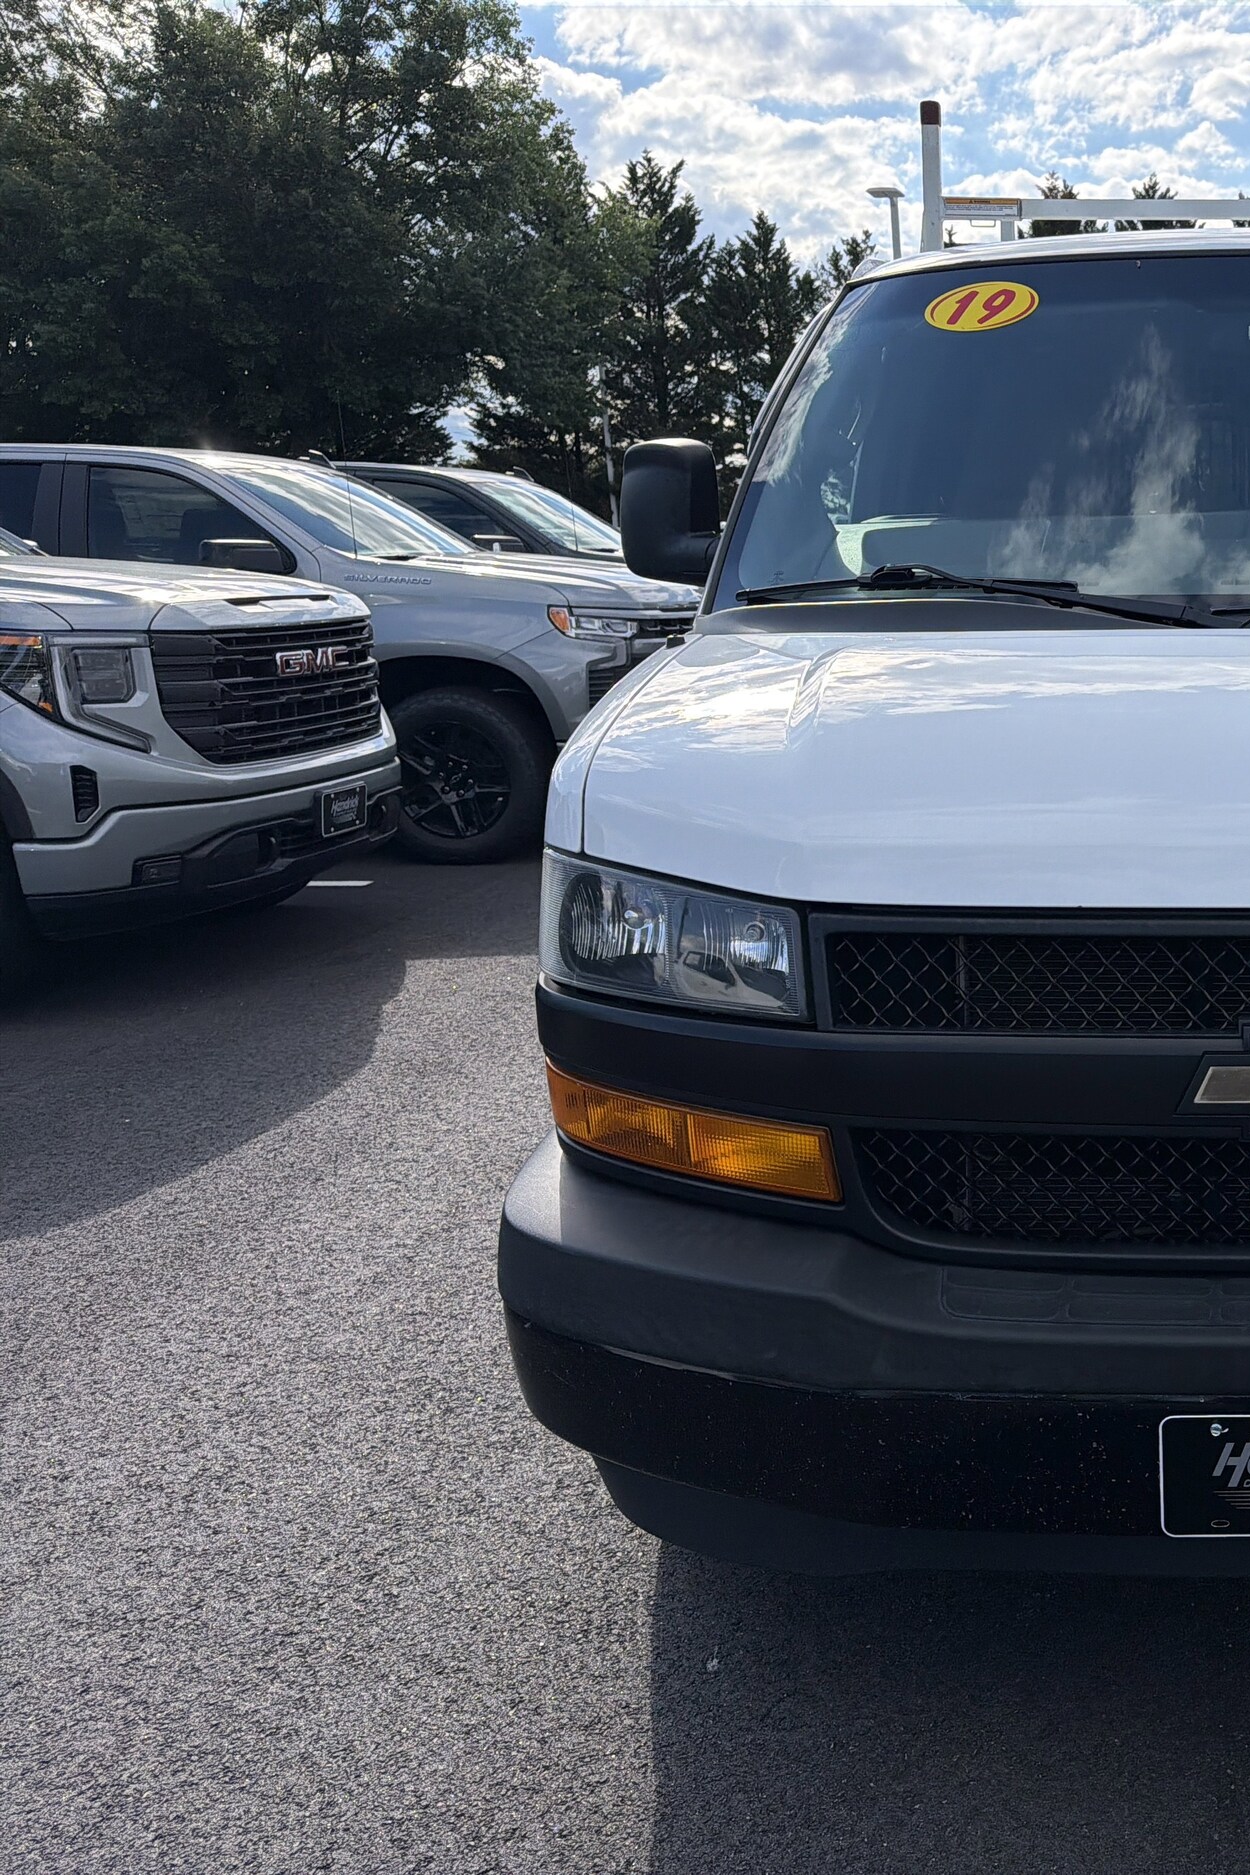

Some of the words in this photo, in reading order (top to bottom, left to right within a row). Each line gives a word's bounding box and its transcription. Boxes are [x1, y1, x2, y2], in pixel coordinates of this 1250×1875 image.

[947, 288, 1016, 325] 19
[344, 574, 432, 585] SILVERADO
[275, 646, 349, 676] GMC
